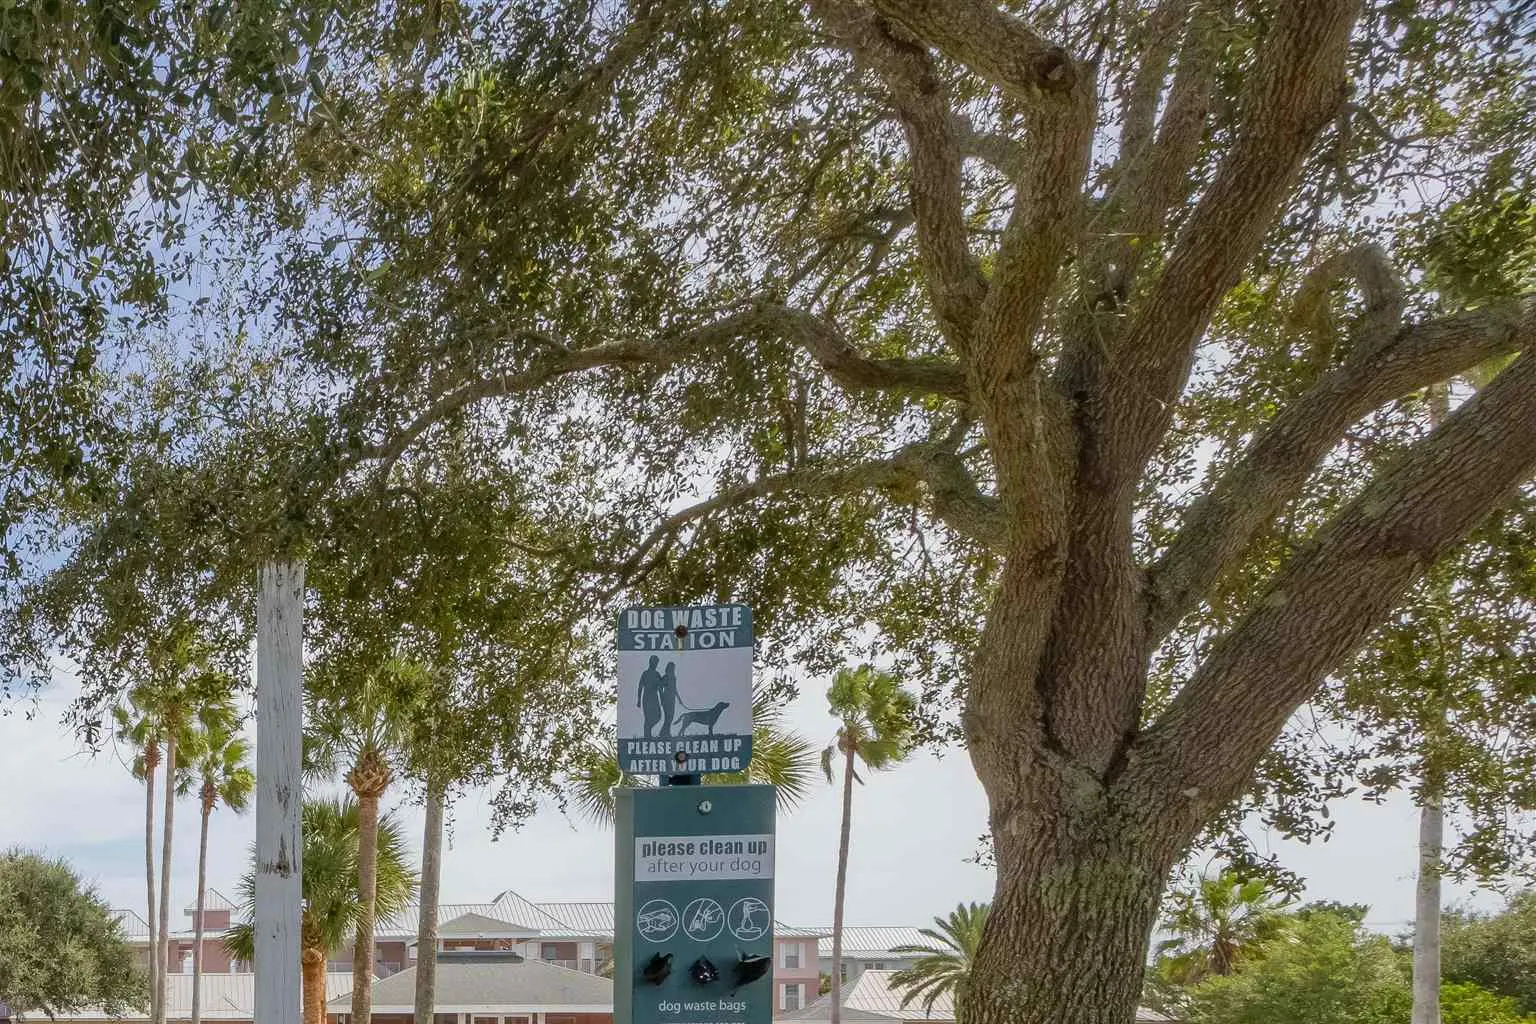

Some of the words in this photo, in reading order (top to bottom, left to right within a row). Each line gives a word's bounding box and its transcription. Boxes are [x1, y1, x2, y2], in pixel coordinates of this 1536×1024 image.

[627, 610, 665, 629] DOG
[672, 607, 742, 628] WASTE
[627, 741, 672, 755] PLEASE
[675, 740, 719, 754] CLEAN
[723, 739, 742, 753] UP
[629, 759, 667, 773] AFTER
[671, 758, 706, 772] YOUR
[711, 756, 740, 771] DOG
[642, 840, 695, 858] please
[699, 839, 744, 855] clean
[747, 840, 767, 856] up
[647, 857, 686, 873] after
[689, 859, 725, 876] your
[730, 857, 761, 875] dog
[658, 1000, 681, 1014] dog
[684, 1000, 716, 1011] waste
[719, 999, 746, 1013] bags
